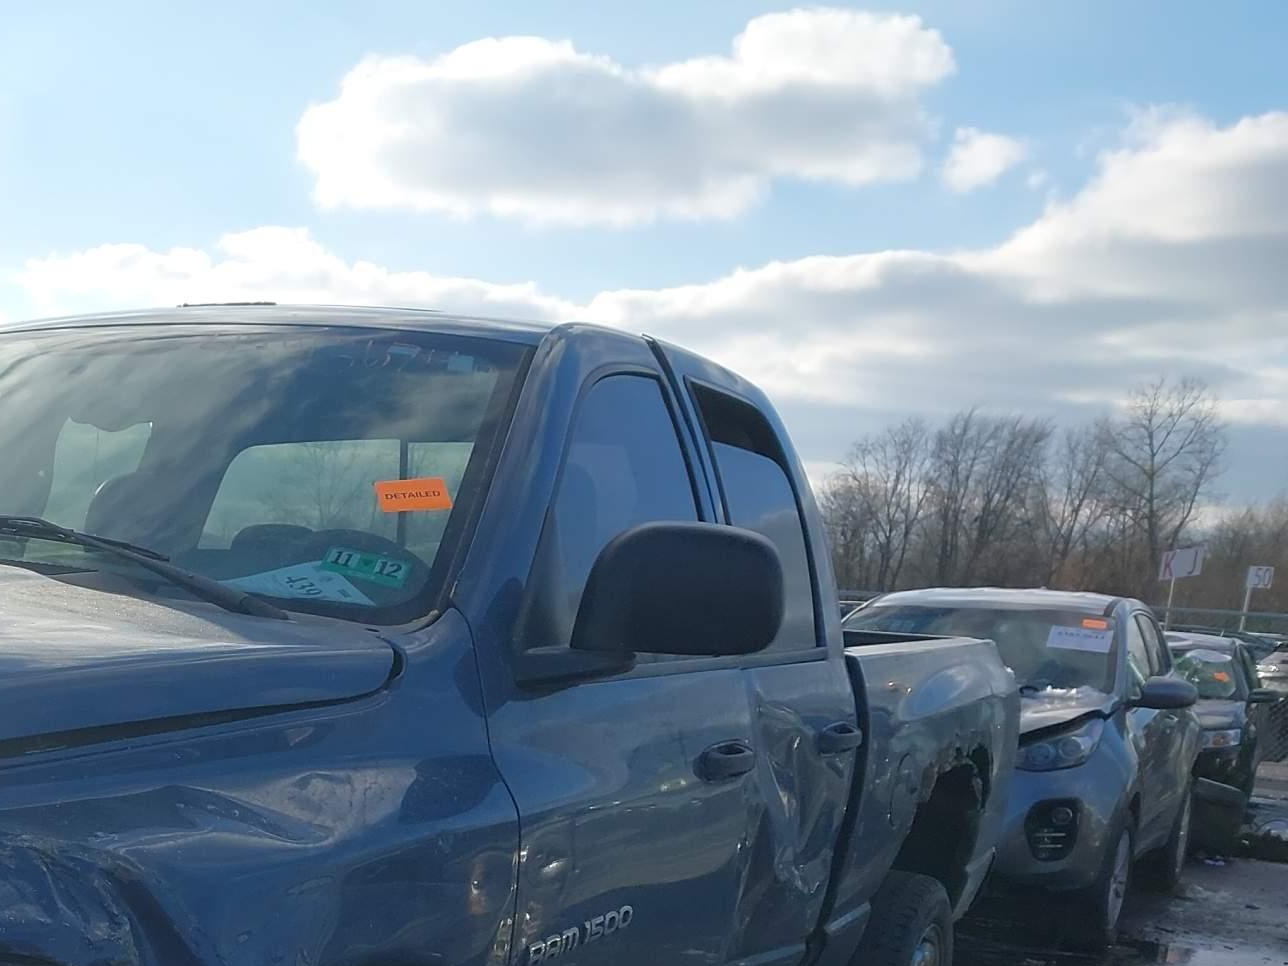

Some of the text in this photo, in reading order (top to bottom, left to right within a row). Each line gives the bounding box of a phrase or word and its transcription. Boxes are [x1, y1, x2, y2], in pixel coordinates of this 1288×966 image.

[384, 489, 441, 500] DETAILED
[330, 551, 402, 578] 11 12
[1162, 551, 1177, 577] K
[1187, 551, 1199, 575] J
[528, 905, 634, 963] RAM 1500
